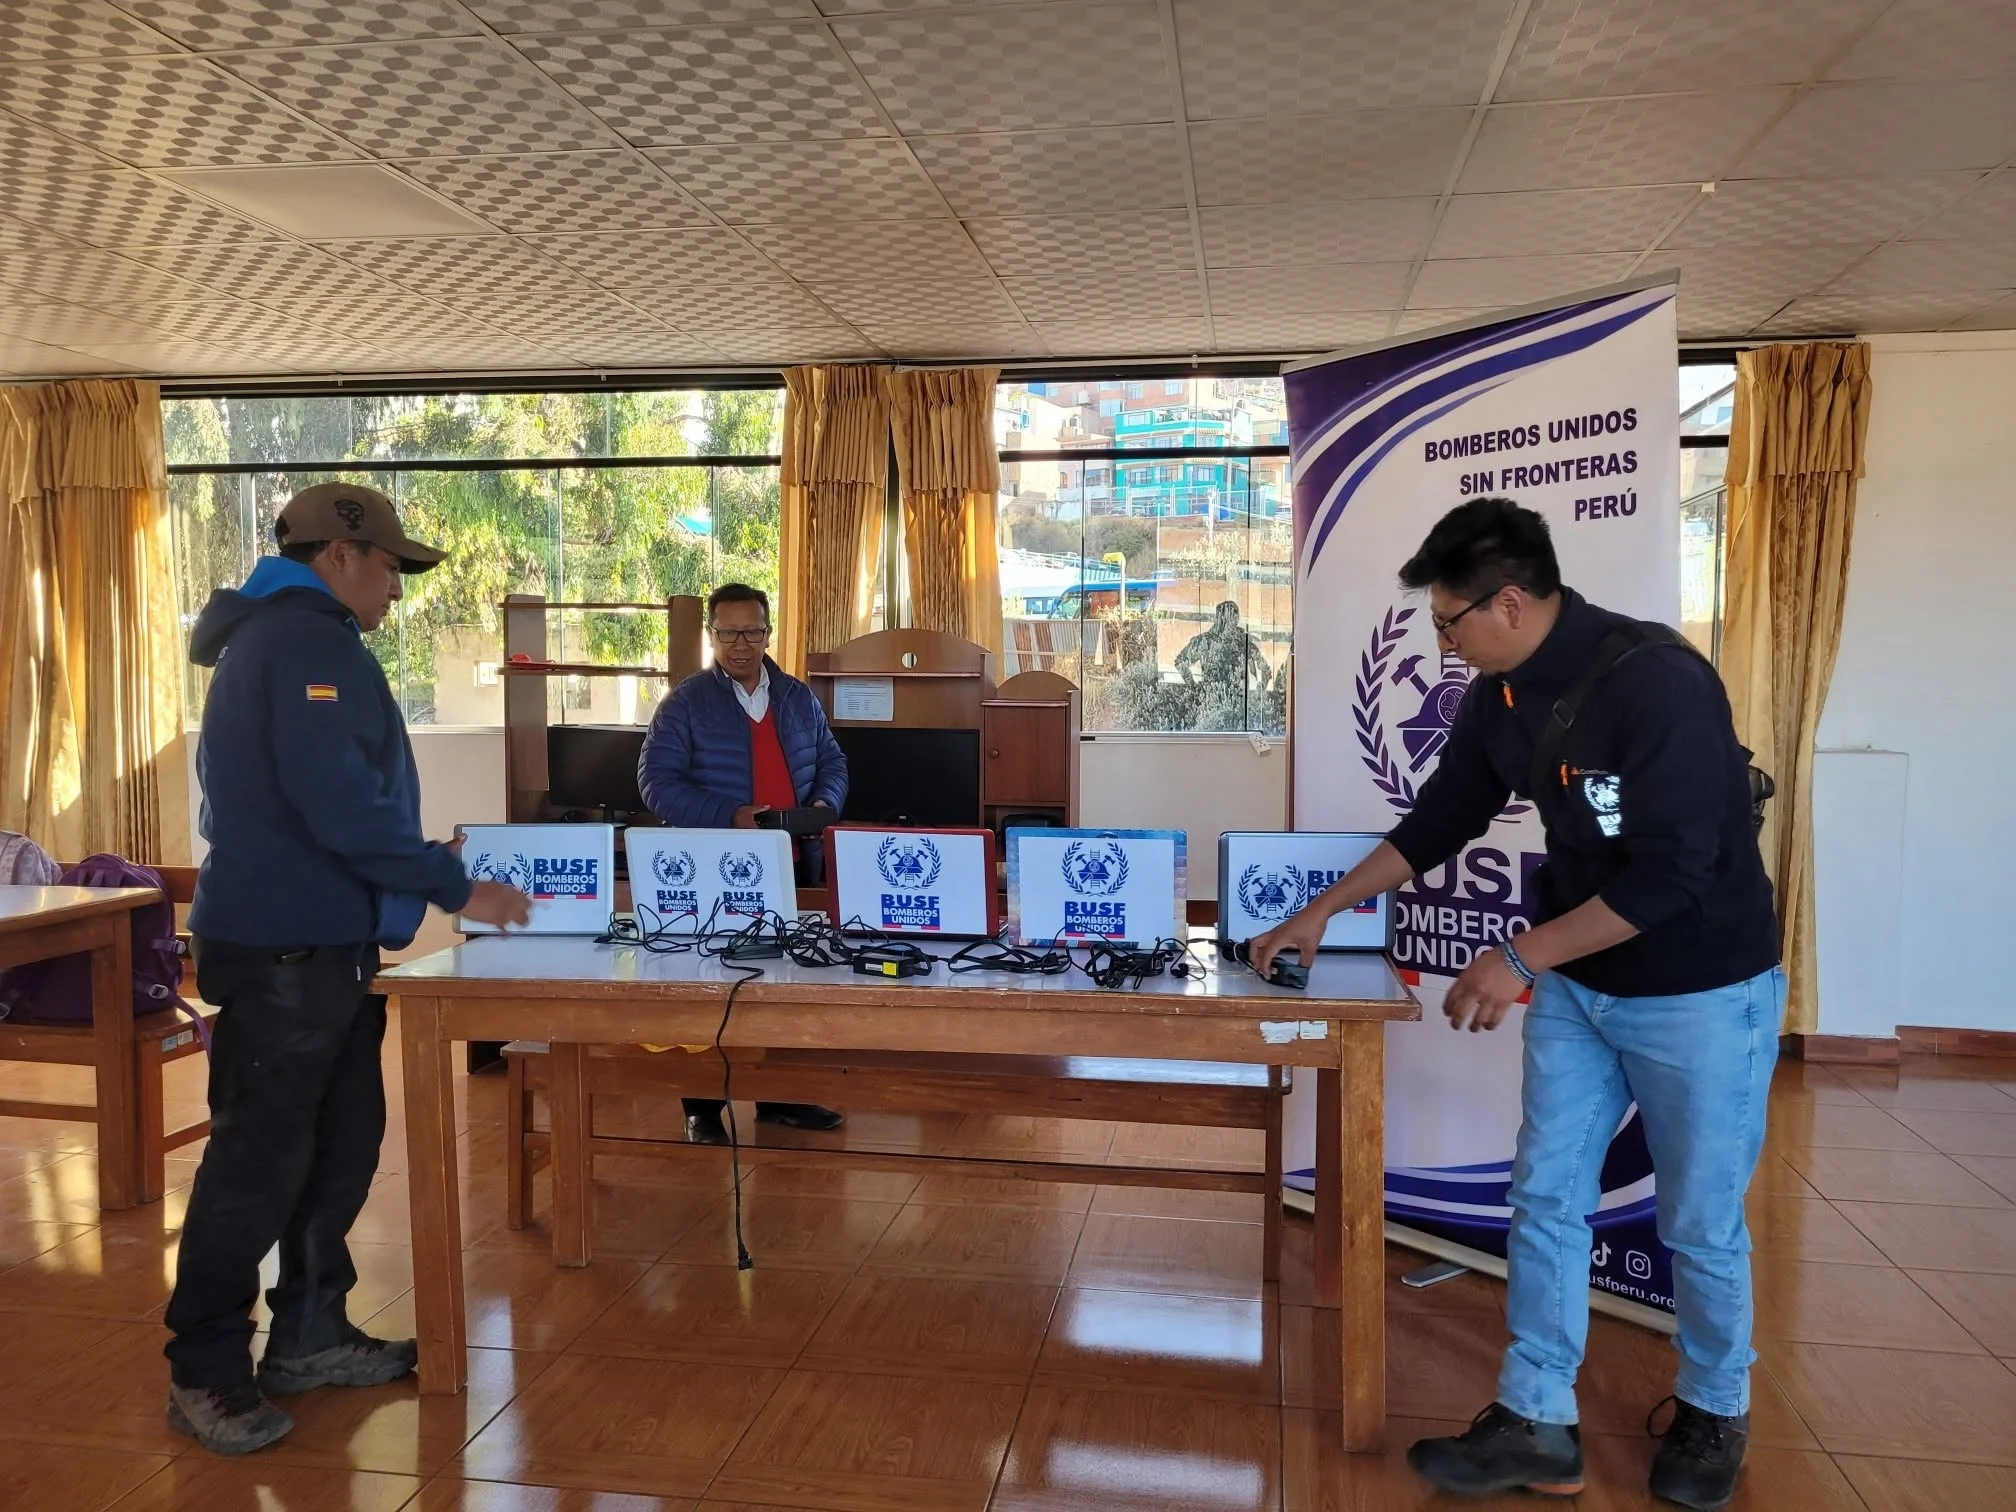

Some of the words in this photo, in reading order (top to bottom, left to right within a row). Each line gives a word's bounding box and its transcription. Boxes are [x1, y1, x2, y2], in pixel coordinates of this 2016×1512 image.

[1424, 424, 1541, 463] BOMBEROS
[1548, 407, 1638, 443] UNIDOS
[1459, 470, 1494, 496] SIN
[1501, 450, 1638, 490] FRONTERAS
[1574, 487, 1637, 522] PERÚ
[534, 858, 598, 873] BUSF
[535, 874, 595, 884] BOMBEROS
[543, 883, 587, 893] UNIDOS
[656, 889, 697, 900] BUSF
[723, 891, 764, 901] BUSF
[881, 893, 940, 908] BUSF
[883, 907, 938, 917] BOMBEROS
[1064, 900, 1126, 915] BUSF
[891, 915, 931, 925] UNIDOS
[1066, 915, 1123, 925] BOMBEROS
[1396, 901, 1532, 943] OMBERO
[1074, 923, 1115, 933] UNIDOS
[1393, 933, 1494, 970] UNID
